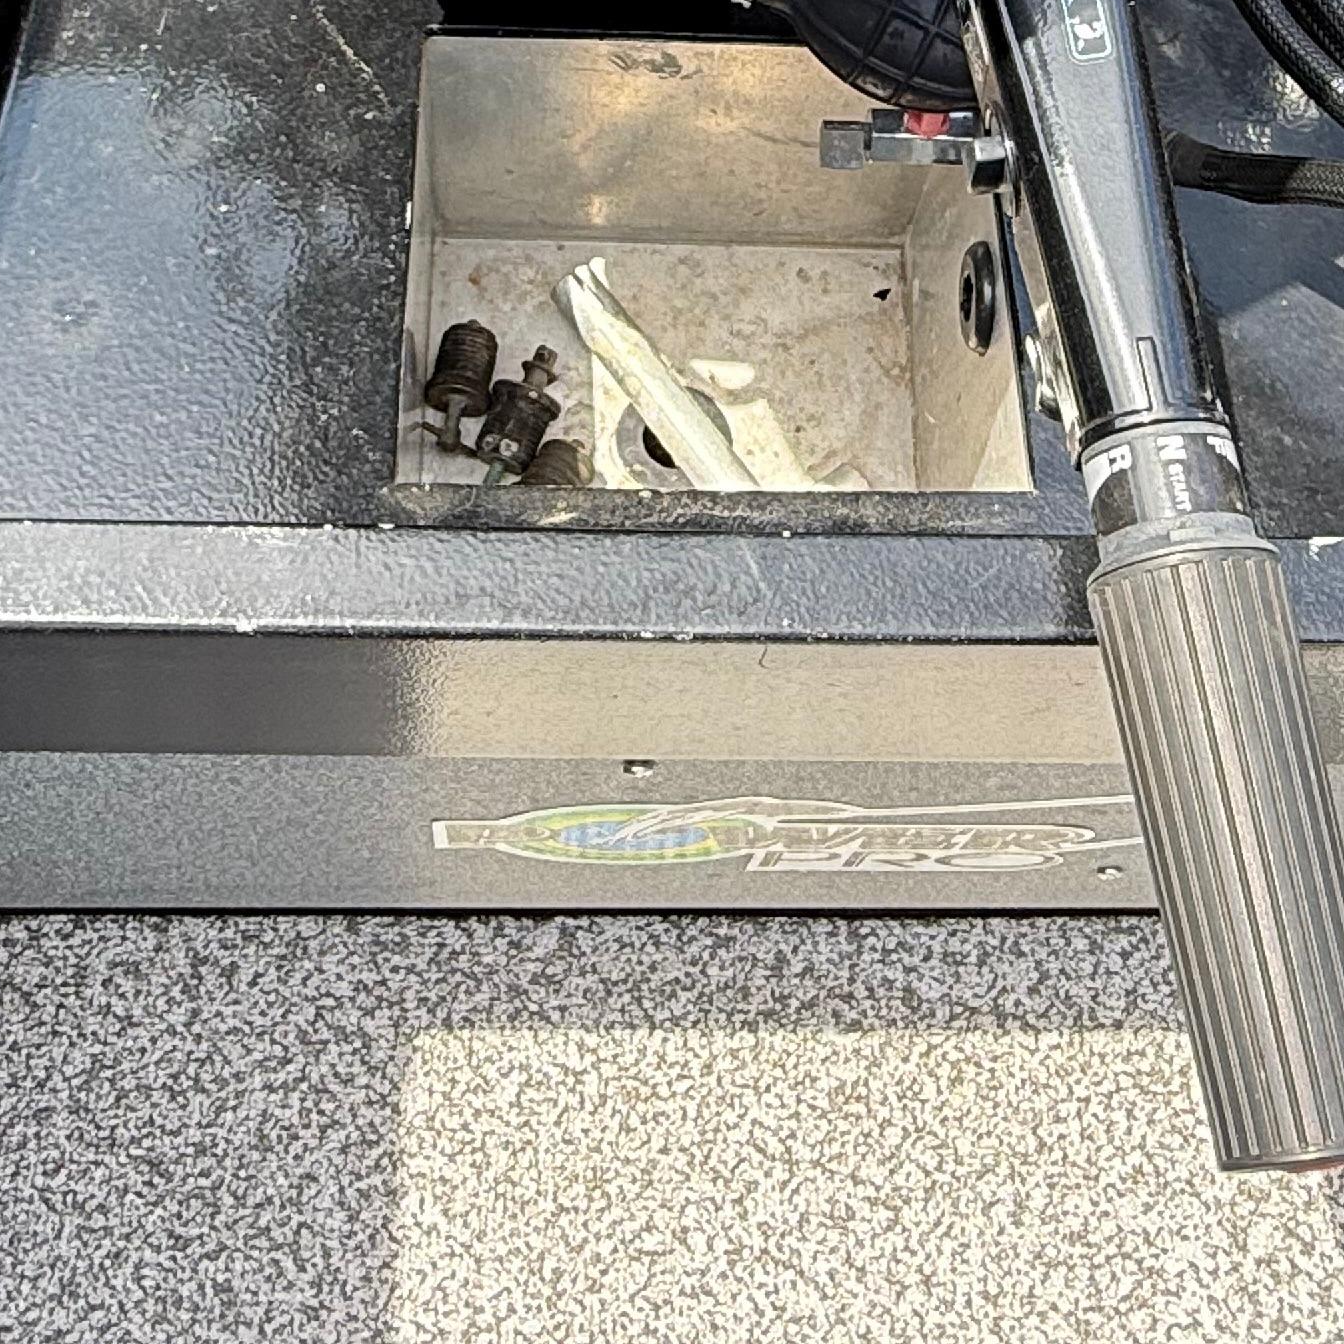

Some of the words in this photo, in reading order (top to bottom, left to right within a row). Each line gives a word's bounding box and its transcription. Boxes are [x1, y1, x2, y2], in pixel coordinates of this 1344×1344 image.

[1109, 444, 1132, 473] R
[1156, 435, 1187, 460] N
[753, 850, 1060, 870] PRO
